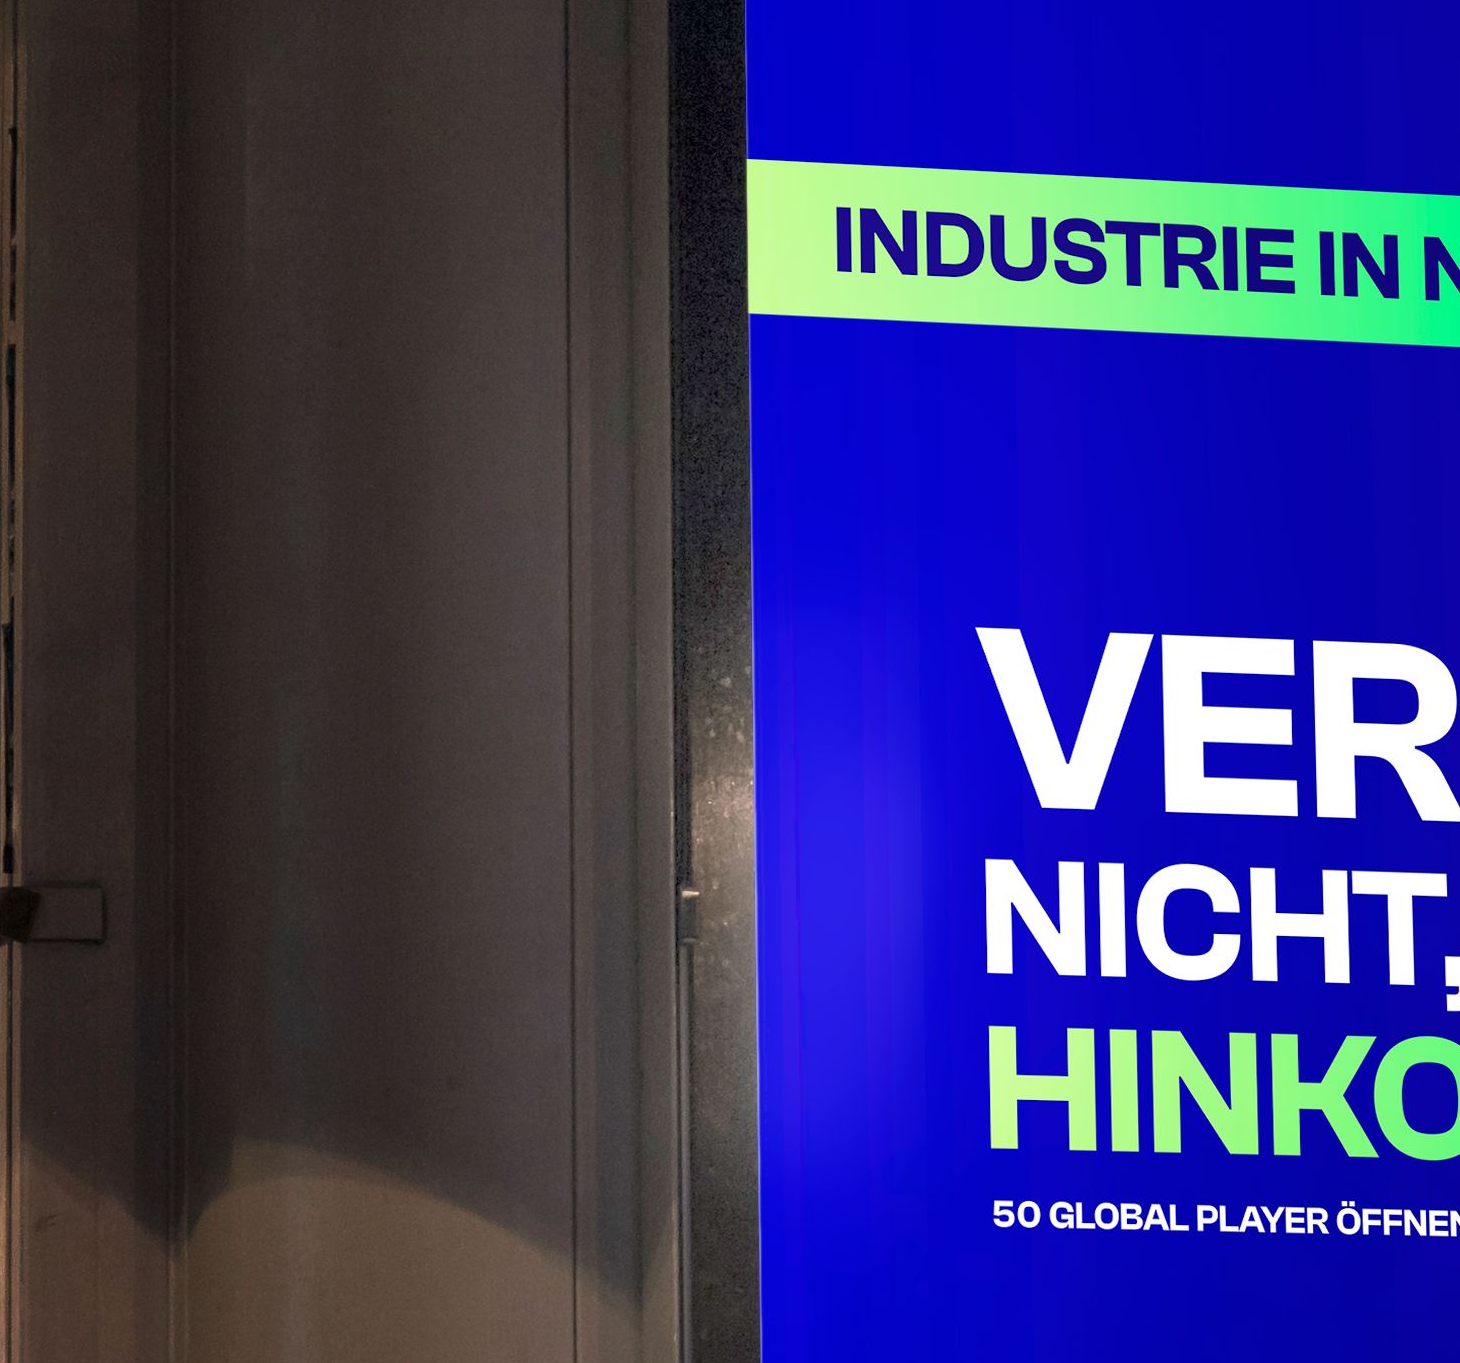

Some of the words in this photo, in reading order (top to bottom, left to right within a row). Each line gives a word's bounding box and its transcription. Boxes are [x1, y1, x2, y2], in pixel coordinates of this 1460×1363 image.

[836, 206, 1296, 294] INDUSTRIE
[1319, 230, 1400, 300] IN
[993, 1199, 1041, 1229] 50
[1049, 1201, 1190, 1232] GLOBAL
[1196, 1204, 1330, 1235] PLAYER
